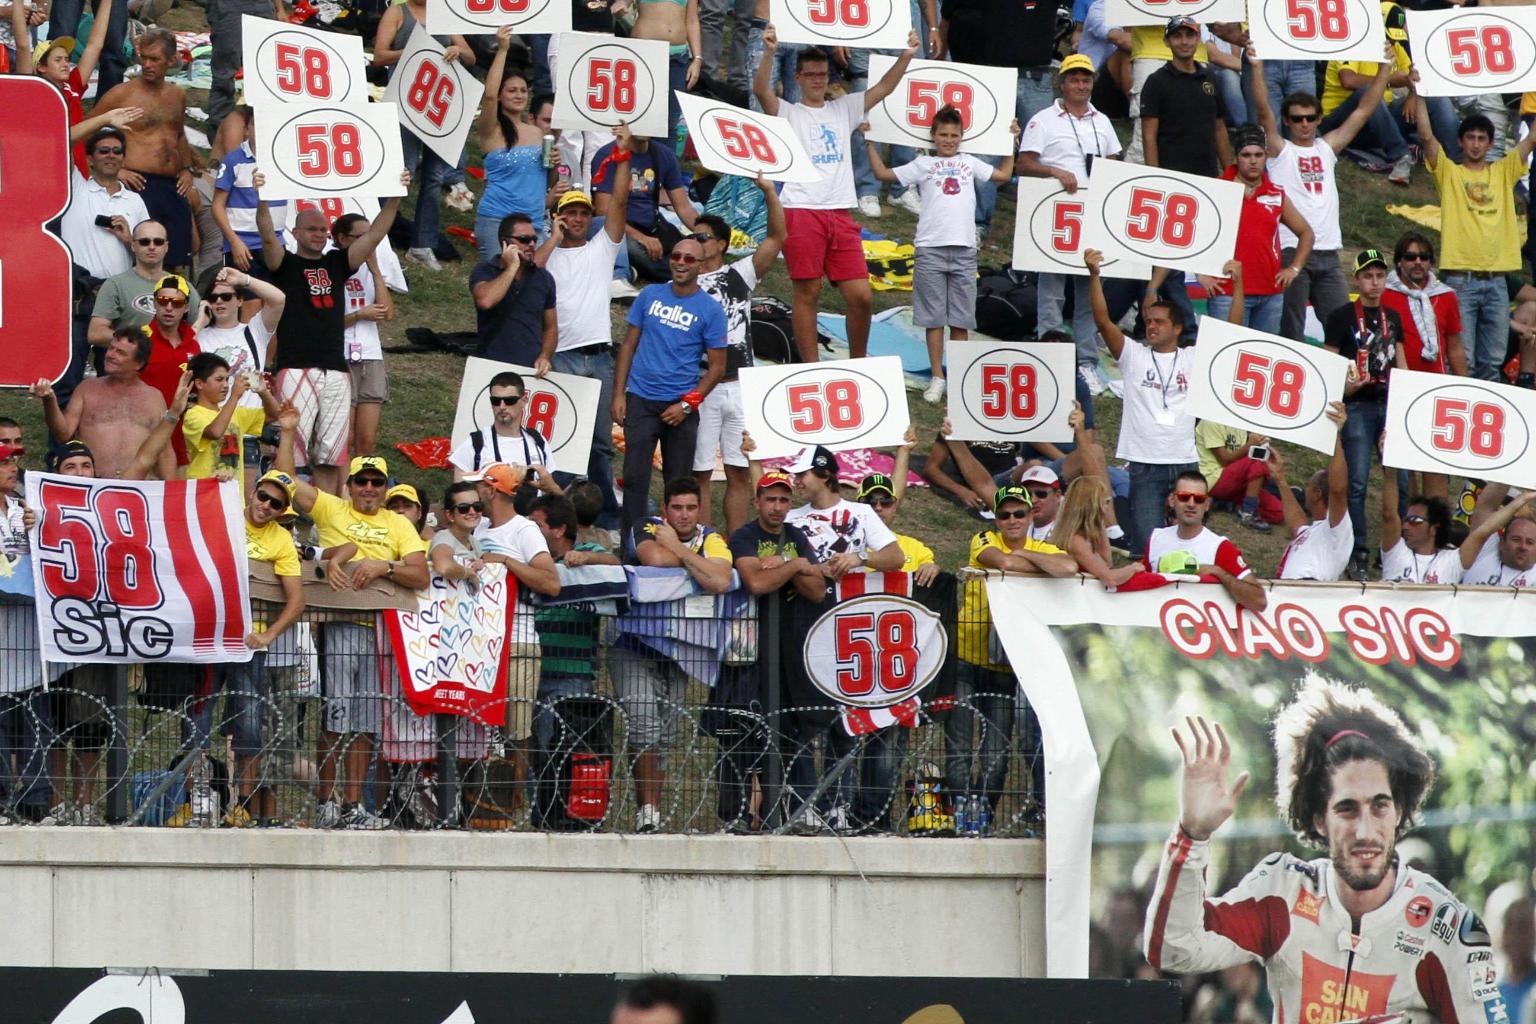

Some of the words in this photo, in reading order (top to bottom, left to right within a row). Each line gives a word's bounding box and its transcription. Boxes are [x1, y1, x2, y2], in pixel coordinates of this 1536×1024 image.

[274, 42, 333, 100] 58
[1446, 25, 1516, 76] 58
[405, 58, 456, 129] 58
[585, 57, 638, 114] 58
[906, 79, 974, 133] 58
[295, 122, 364, 178] 58
[715, 117, 778, 165] 58
[1297, 155, 1324, 173] 58
[1124, 187, 1199, 249] 58
[304, 268, 332, 288] 58
[648, 299, 694, 327] italia
[786, 379, 863, 434] 58
[980, 363, 1039, 421] 58
[1231, 351, 1306, 419] 58
[512, 389, 559, 443] 8
[1431, 397, 1506, 459] 58
[38, 479, 165, 610] 58
[833, 609, 921, 698] 58
[1159, 597, 1331, 664] CIAO
[1338, 604, 1462, 672] SIC
[1320, 979, 1370, 1012] SAN
